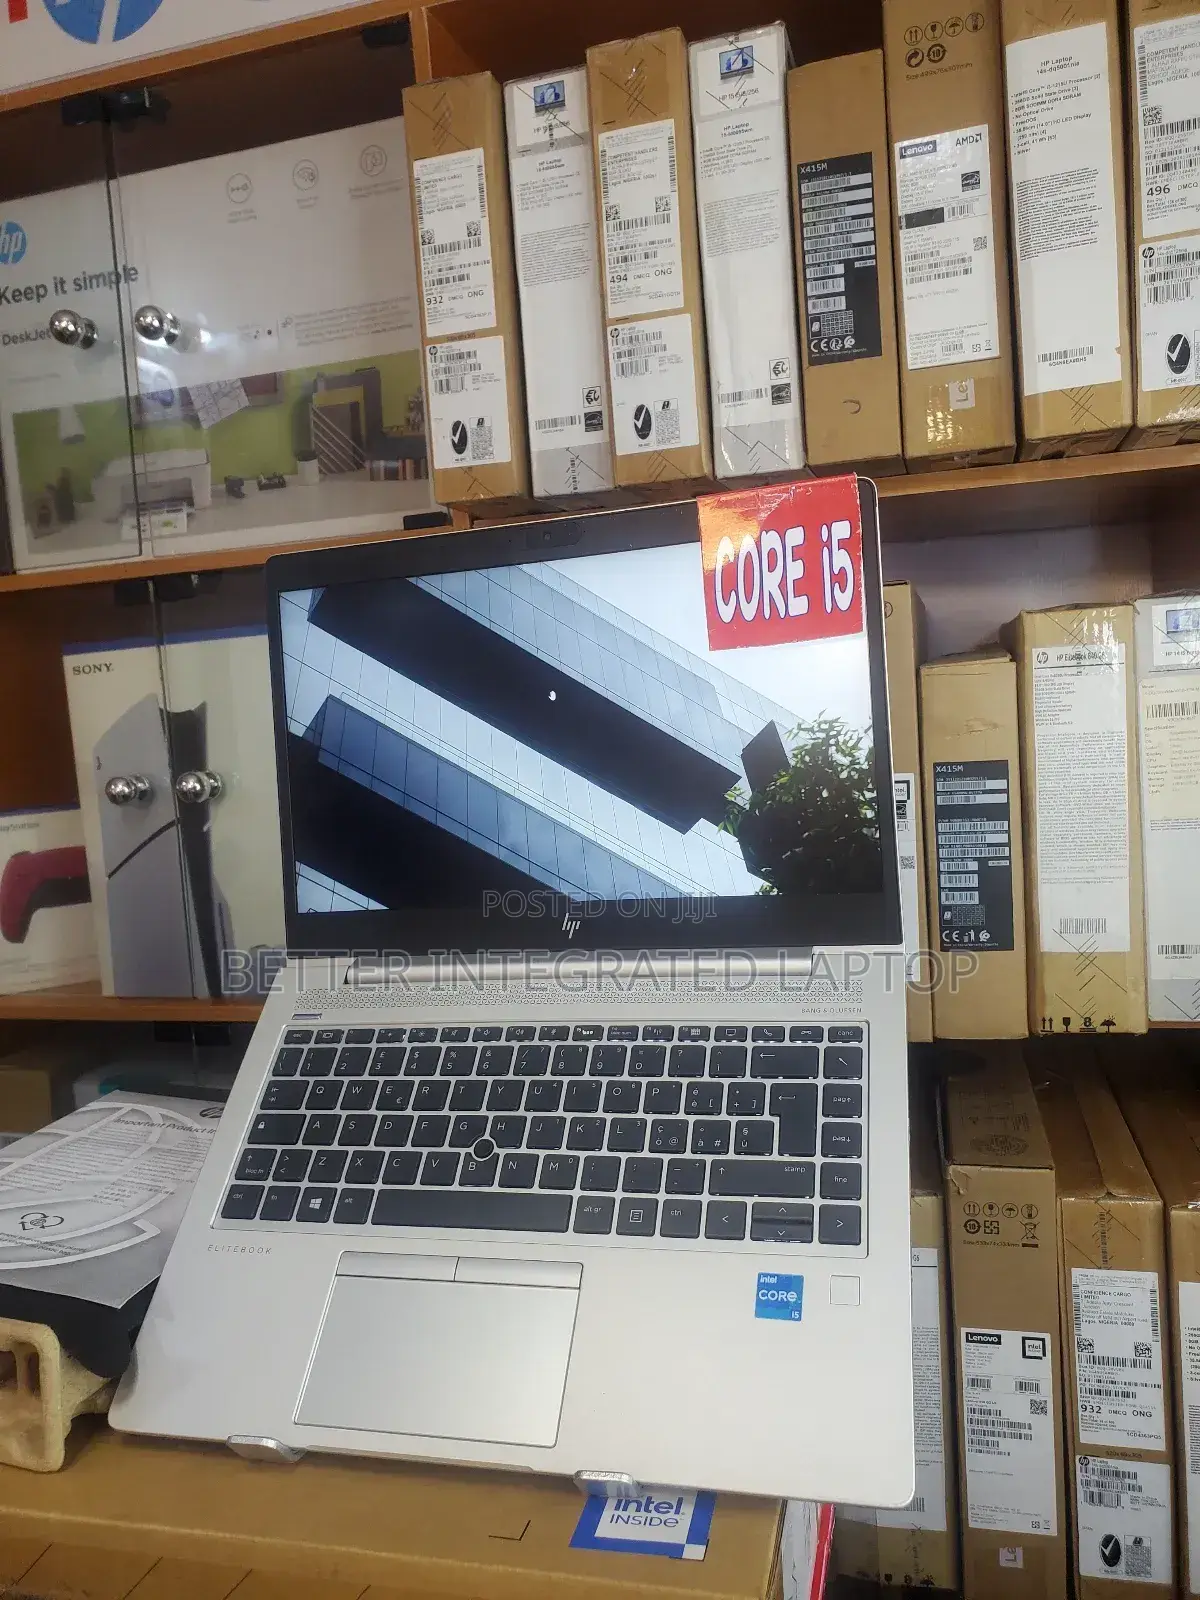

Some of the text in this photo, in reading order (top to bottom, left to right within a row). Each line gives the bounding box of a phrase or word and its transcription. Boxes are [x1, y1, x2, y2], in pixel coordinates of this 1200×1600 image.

[1146, 46, 1179, 58] COMPETENT
[1051, 56, 1073, 65] Laptop
[1073, 112, 1092, 121] Display
[955, 135, 975, 147] AMD
[902, 143, 934, 156] Lenovo
[800, 162, 828, 174] X415M
[1147, 181, 1199, 197] 496 DMCQ
[610, 273, 628, 284] 494
[654, 267, 673, 277] ONG
[0, 264, 139, 306] Keep it simple
[426, 296, 443, 306] 932
[468, 289, 485, 298] ONG
[2, 328, 51, 346] DeskJet
[714, 519, 855, 624] CORE i5
[72, 662, 112, 676] SONY
[935, 764, 963, 773] X415M
[113, 1117, 166, 1129] Important
[166, 1123, 204, 1134] Product
[784, 1166, 806, 1174] stamp
[207, 1244, 272, 1255] ELITEBOOK
[760, 1275, 777, 1283] intel
[967, 1333, 999, 1343] Lenovo
[1080, 1403, 1102, 1414] 932
[1132, 1409, 1153, 1418] ONG
[613, 1496, 686, 1515] intel
